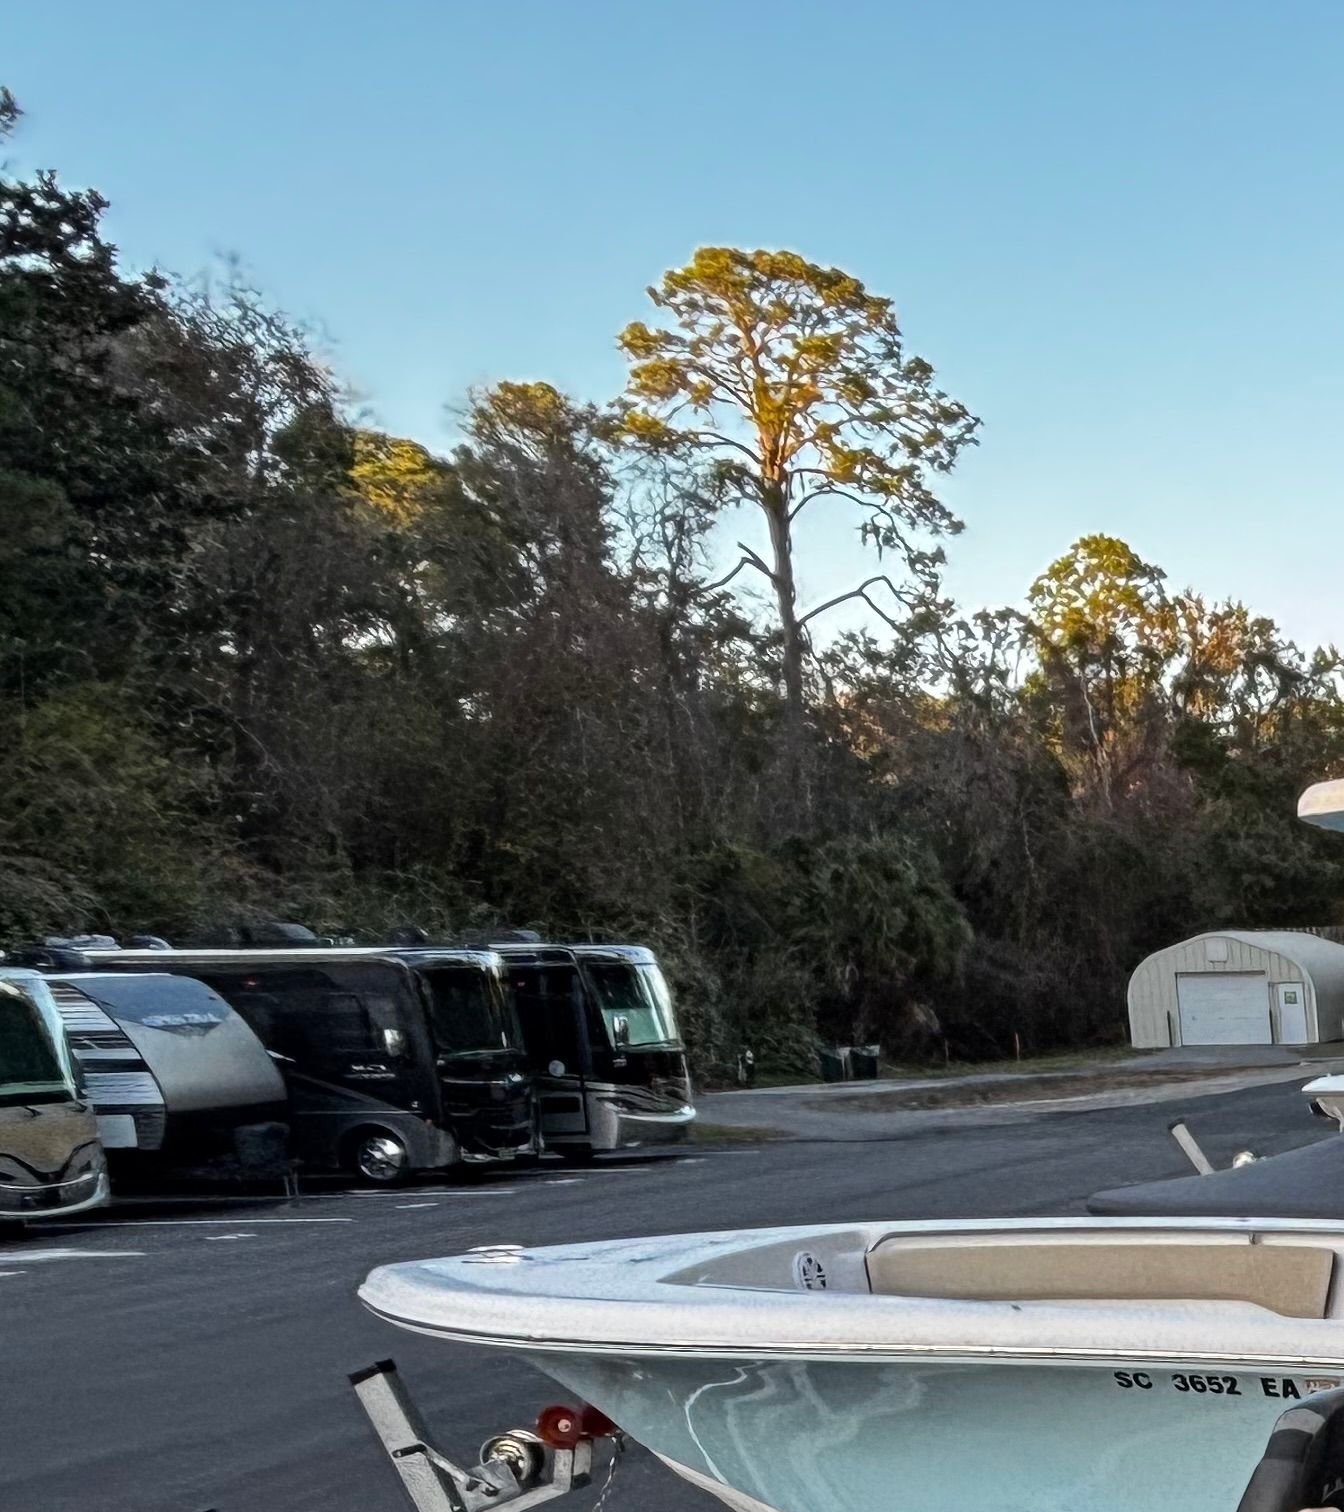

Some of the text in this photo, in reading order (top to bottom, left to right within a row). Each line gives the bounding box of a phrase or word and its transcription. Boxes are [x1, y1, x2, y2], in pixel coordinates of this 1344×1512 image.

[1113, 1371, 1153, 1390] SC
[1171, 1373, 1242, 1396] 3652
[1259, 1377, 1301, 1399] EA
